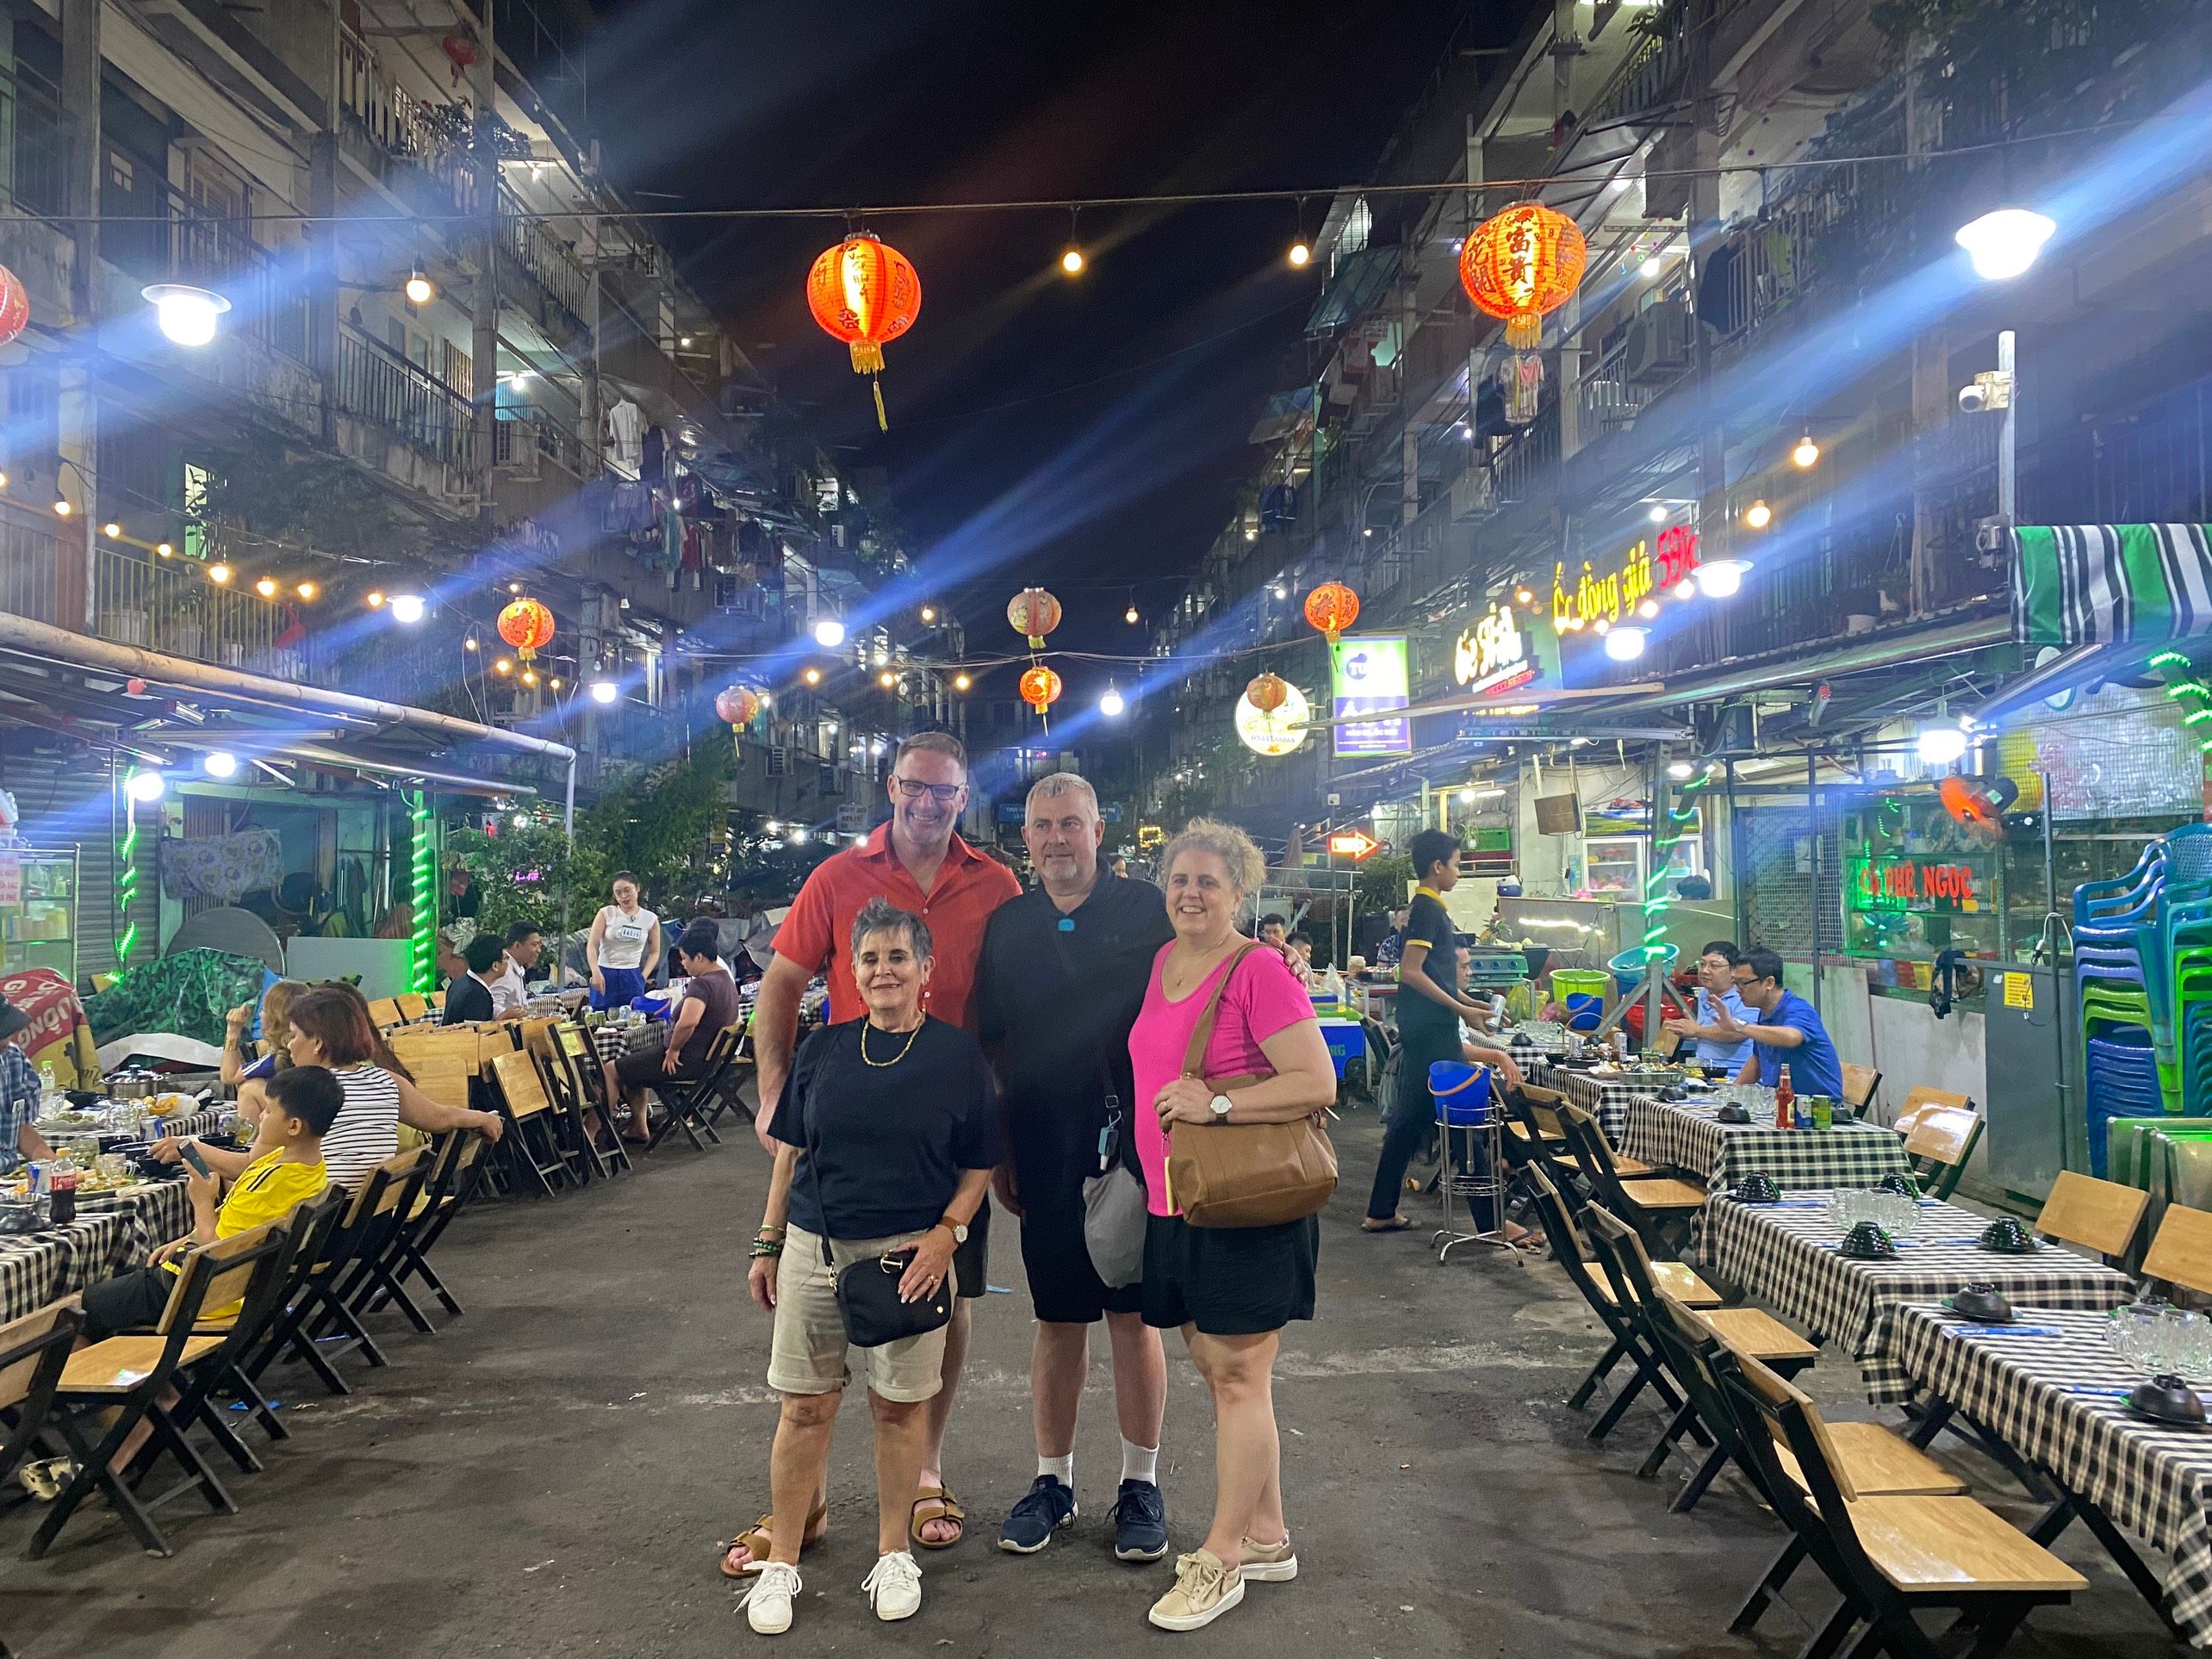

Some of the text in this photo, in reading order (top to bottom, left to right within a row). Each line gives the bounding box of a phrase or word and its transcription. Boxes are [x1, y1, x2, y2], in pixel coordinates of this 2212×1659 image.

[1502, 226, 1533, 287] 富貴
[1577, 561, 1620, 624] đồng
[1622, 539, 1653, 618] giá
[1885, 860, 1916, 898] PHÊ
[1922, 865, 1973, 907] NGỌC
